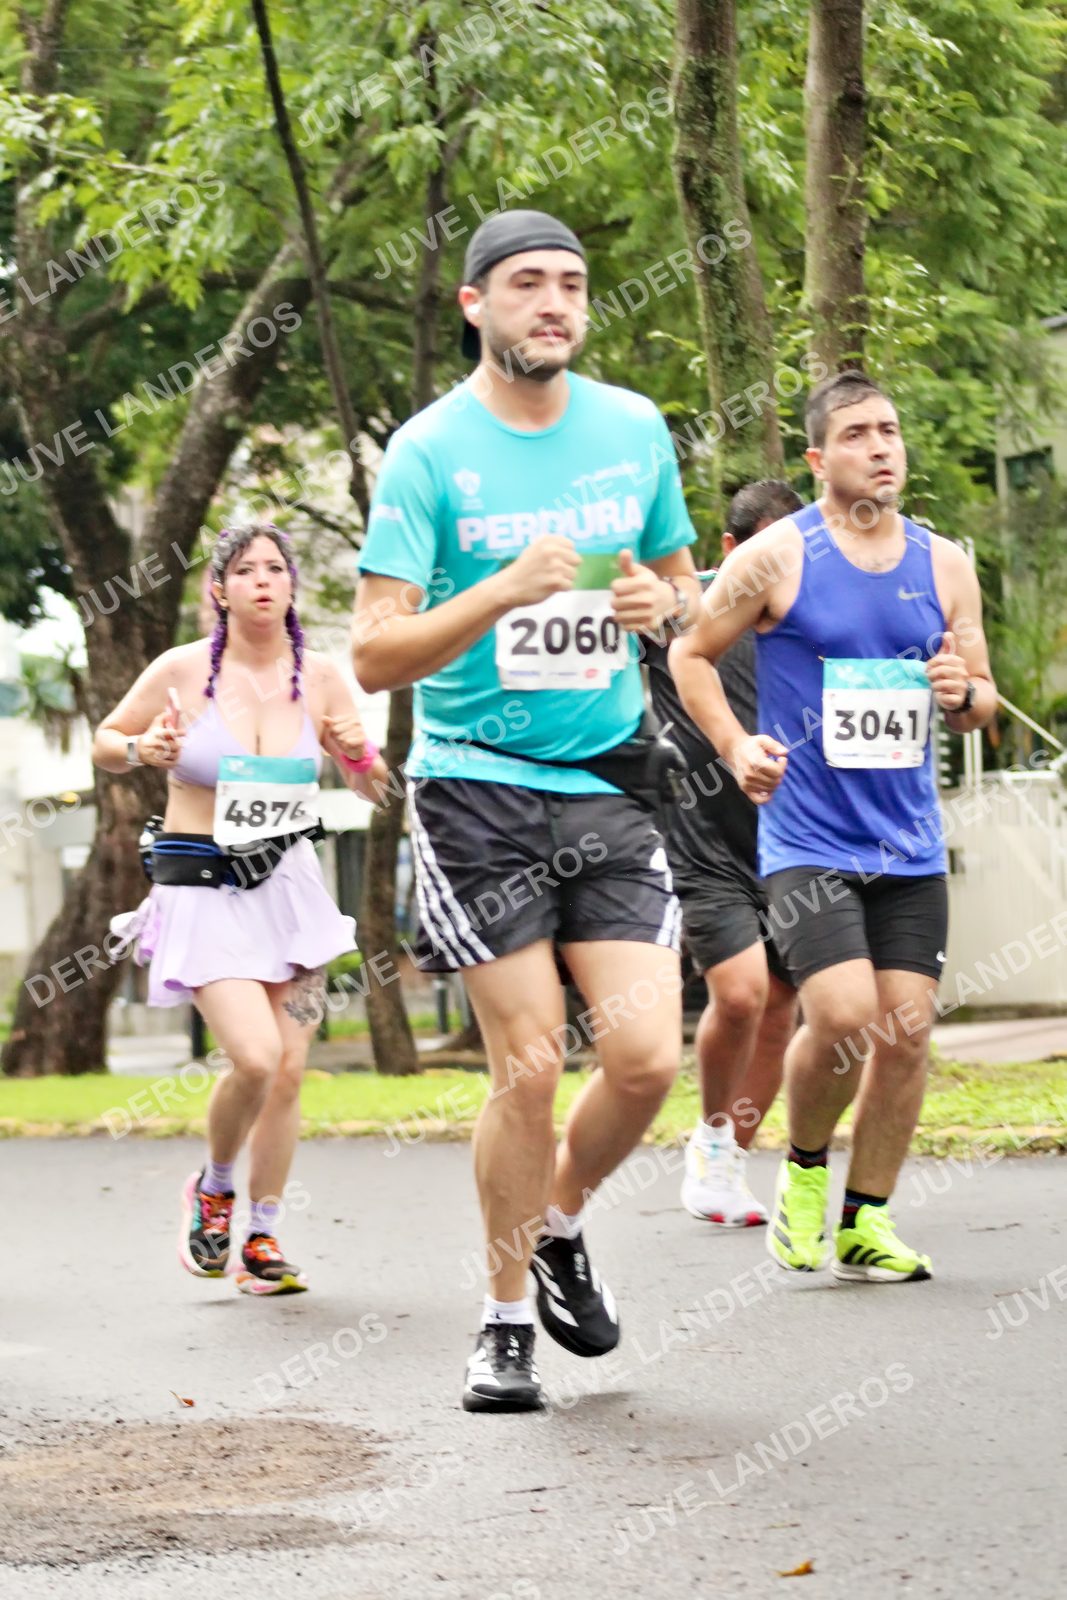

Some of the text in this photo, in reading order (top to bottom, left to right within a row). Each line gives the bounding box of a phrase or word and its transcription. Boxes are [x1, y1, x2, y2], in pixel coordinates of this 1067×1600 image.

[457, 495, 645, 552] PERDURA
[510, 615, 620, 656] 2060
[835, 709, 918, 741] 3041
